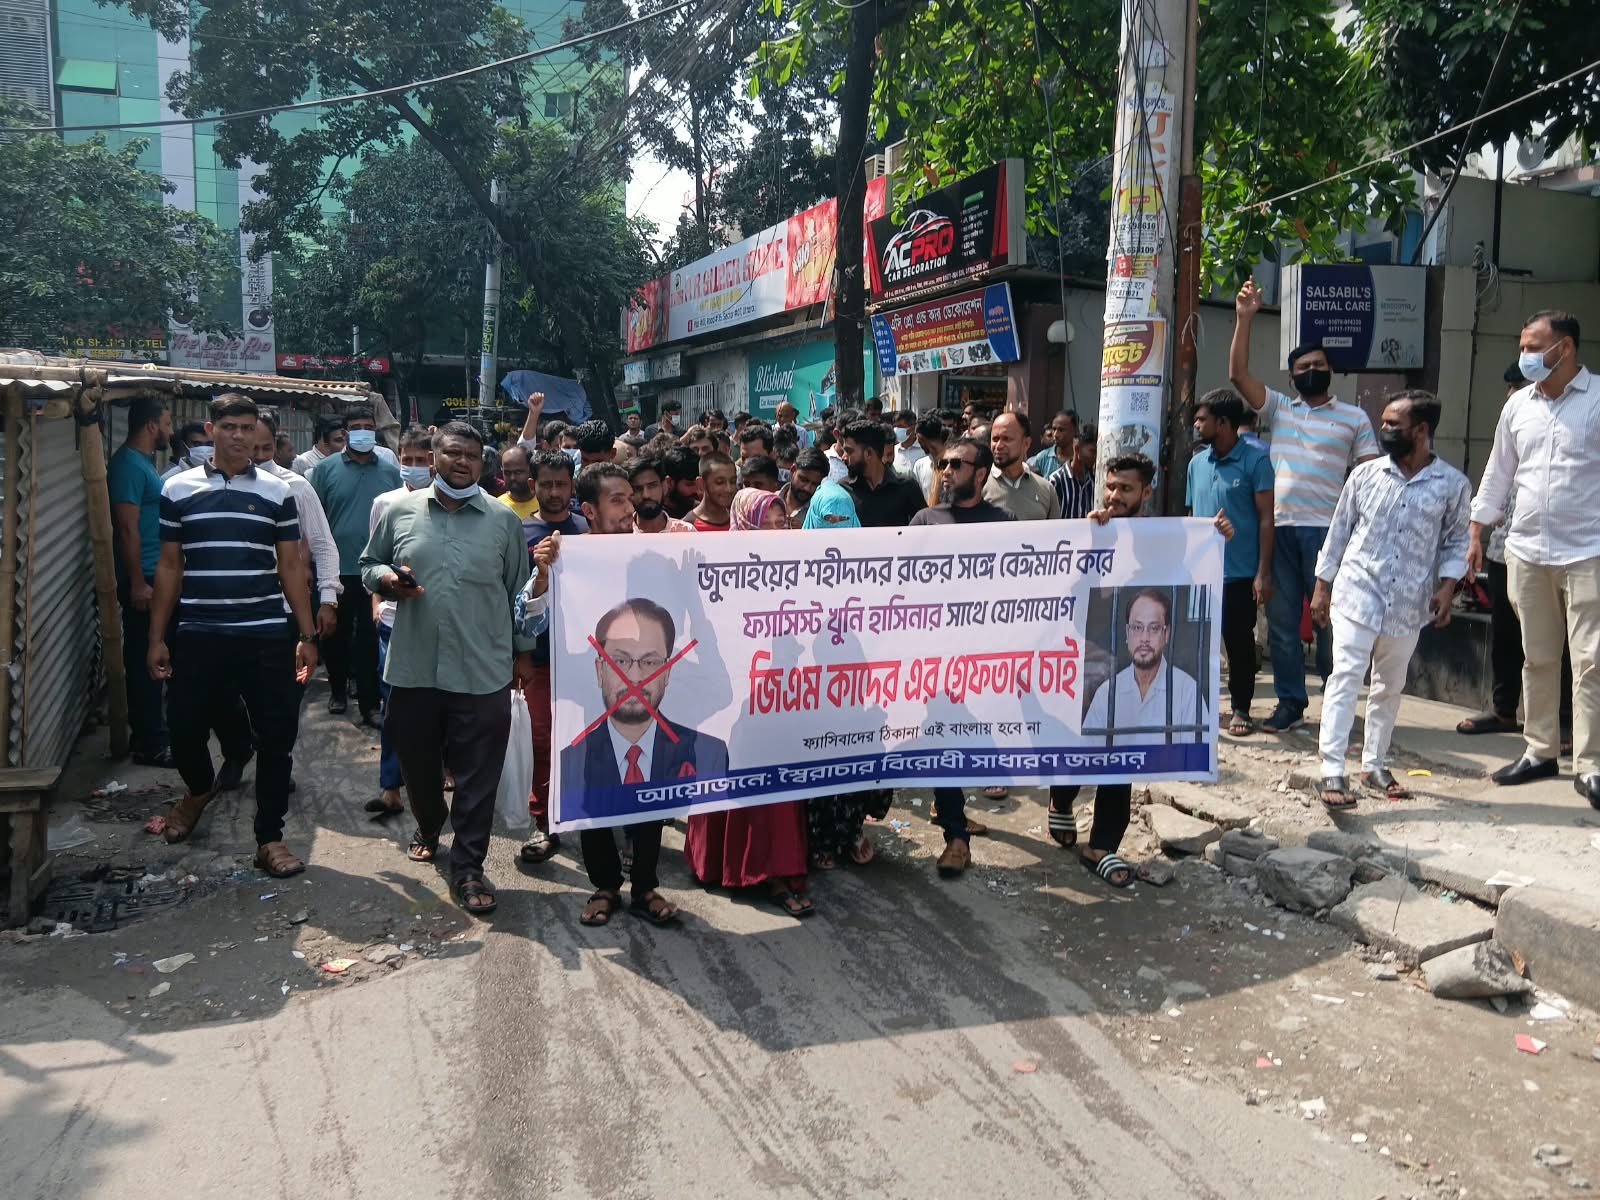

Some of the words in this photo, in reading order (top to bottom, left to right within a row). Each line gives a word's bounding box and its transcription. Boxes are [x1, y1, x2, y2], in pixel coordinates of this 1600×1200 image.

[888, 271, 900, 283] CAR
[902, 256, 947, 278] DECORATION
[1305, 301, 1342, 311] DENTAL
[1345, 301, 1371, 311] CARE
[1306, 285, 1371, 298] SALSABIL'S
[755, 360, 797, 393] Blisbond
[698, 552, 800, 602] জুলাইয়ের
[804, 547, 892, 588] শহীদদের
[898, 554, 954, 585] রক্তের
[958, 552, 996, 580] সঙ্গে
[1000, 540, 1074, 578] বেঈমানি
[1076, 549, 1115, 577] করে
[743, 600, 823, 639] ফ্যাসিস্ট
[827, 596, 864, 646] খুনি
[868, 594, 943, 635] হাসিনার
[946, 600, 988, 627] সাথে
[991, 596, 1076, 624] যোগাযোগ
[749, 650, 822, 716] জিএম
[827, 660, 901, 709] কাদের
[904, 656, 942, 705] এর
[944, 650, 1035, 705] গ্রেফতার
[1038, 636, 1079, 700] চাই
[803, 729, 875, 750] ফ্যাসিবাদের
[879, 720, 920, 742] ঠিকানা
[924, 720, 945, 738] এই
[950, 721, 992, 738] বাংলায়
[997, 722, 1022, 736] হবে
[1026, 721, 1041, 736] না
[778, 759, 876, 784] স্বৈরাচার
[880, 750, 965, 772] বিরোধী
[970, 753, 1059, 769] সাধারণ
